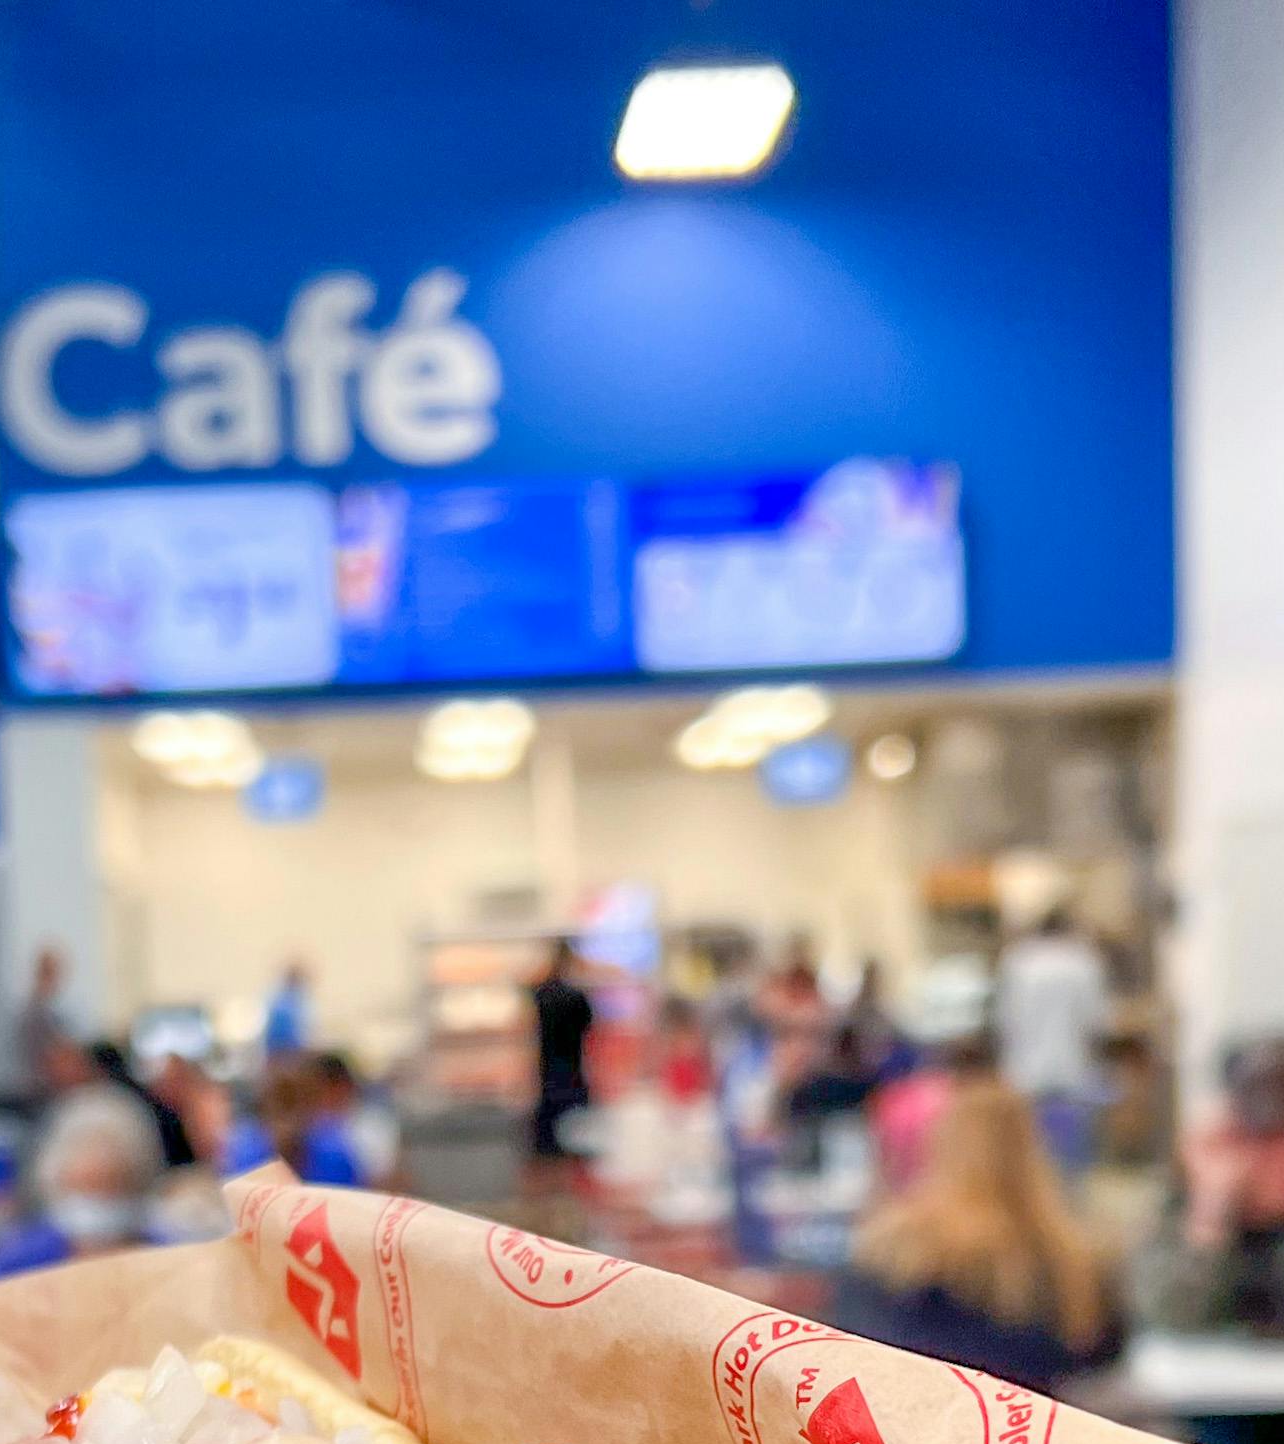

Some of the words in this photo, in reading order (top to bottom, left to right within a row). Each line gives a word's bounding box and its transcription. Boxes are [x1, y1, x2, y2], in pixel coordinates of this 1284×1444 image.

[1, 267, 502, 478] Café
[724, 1332, 762, 1396] Hot
[796, 1367, 820, 1410] TM
